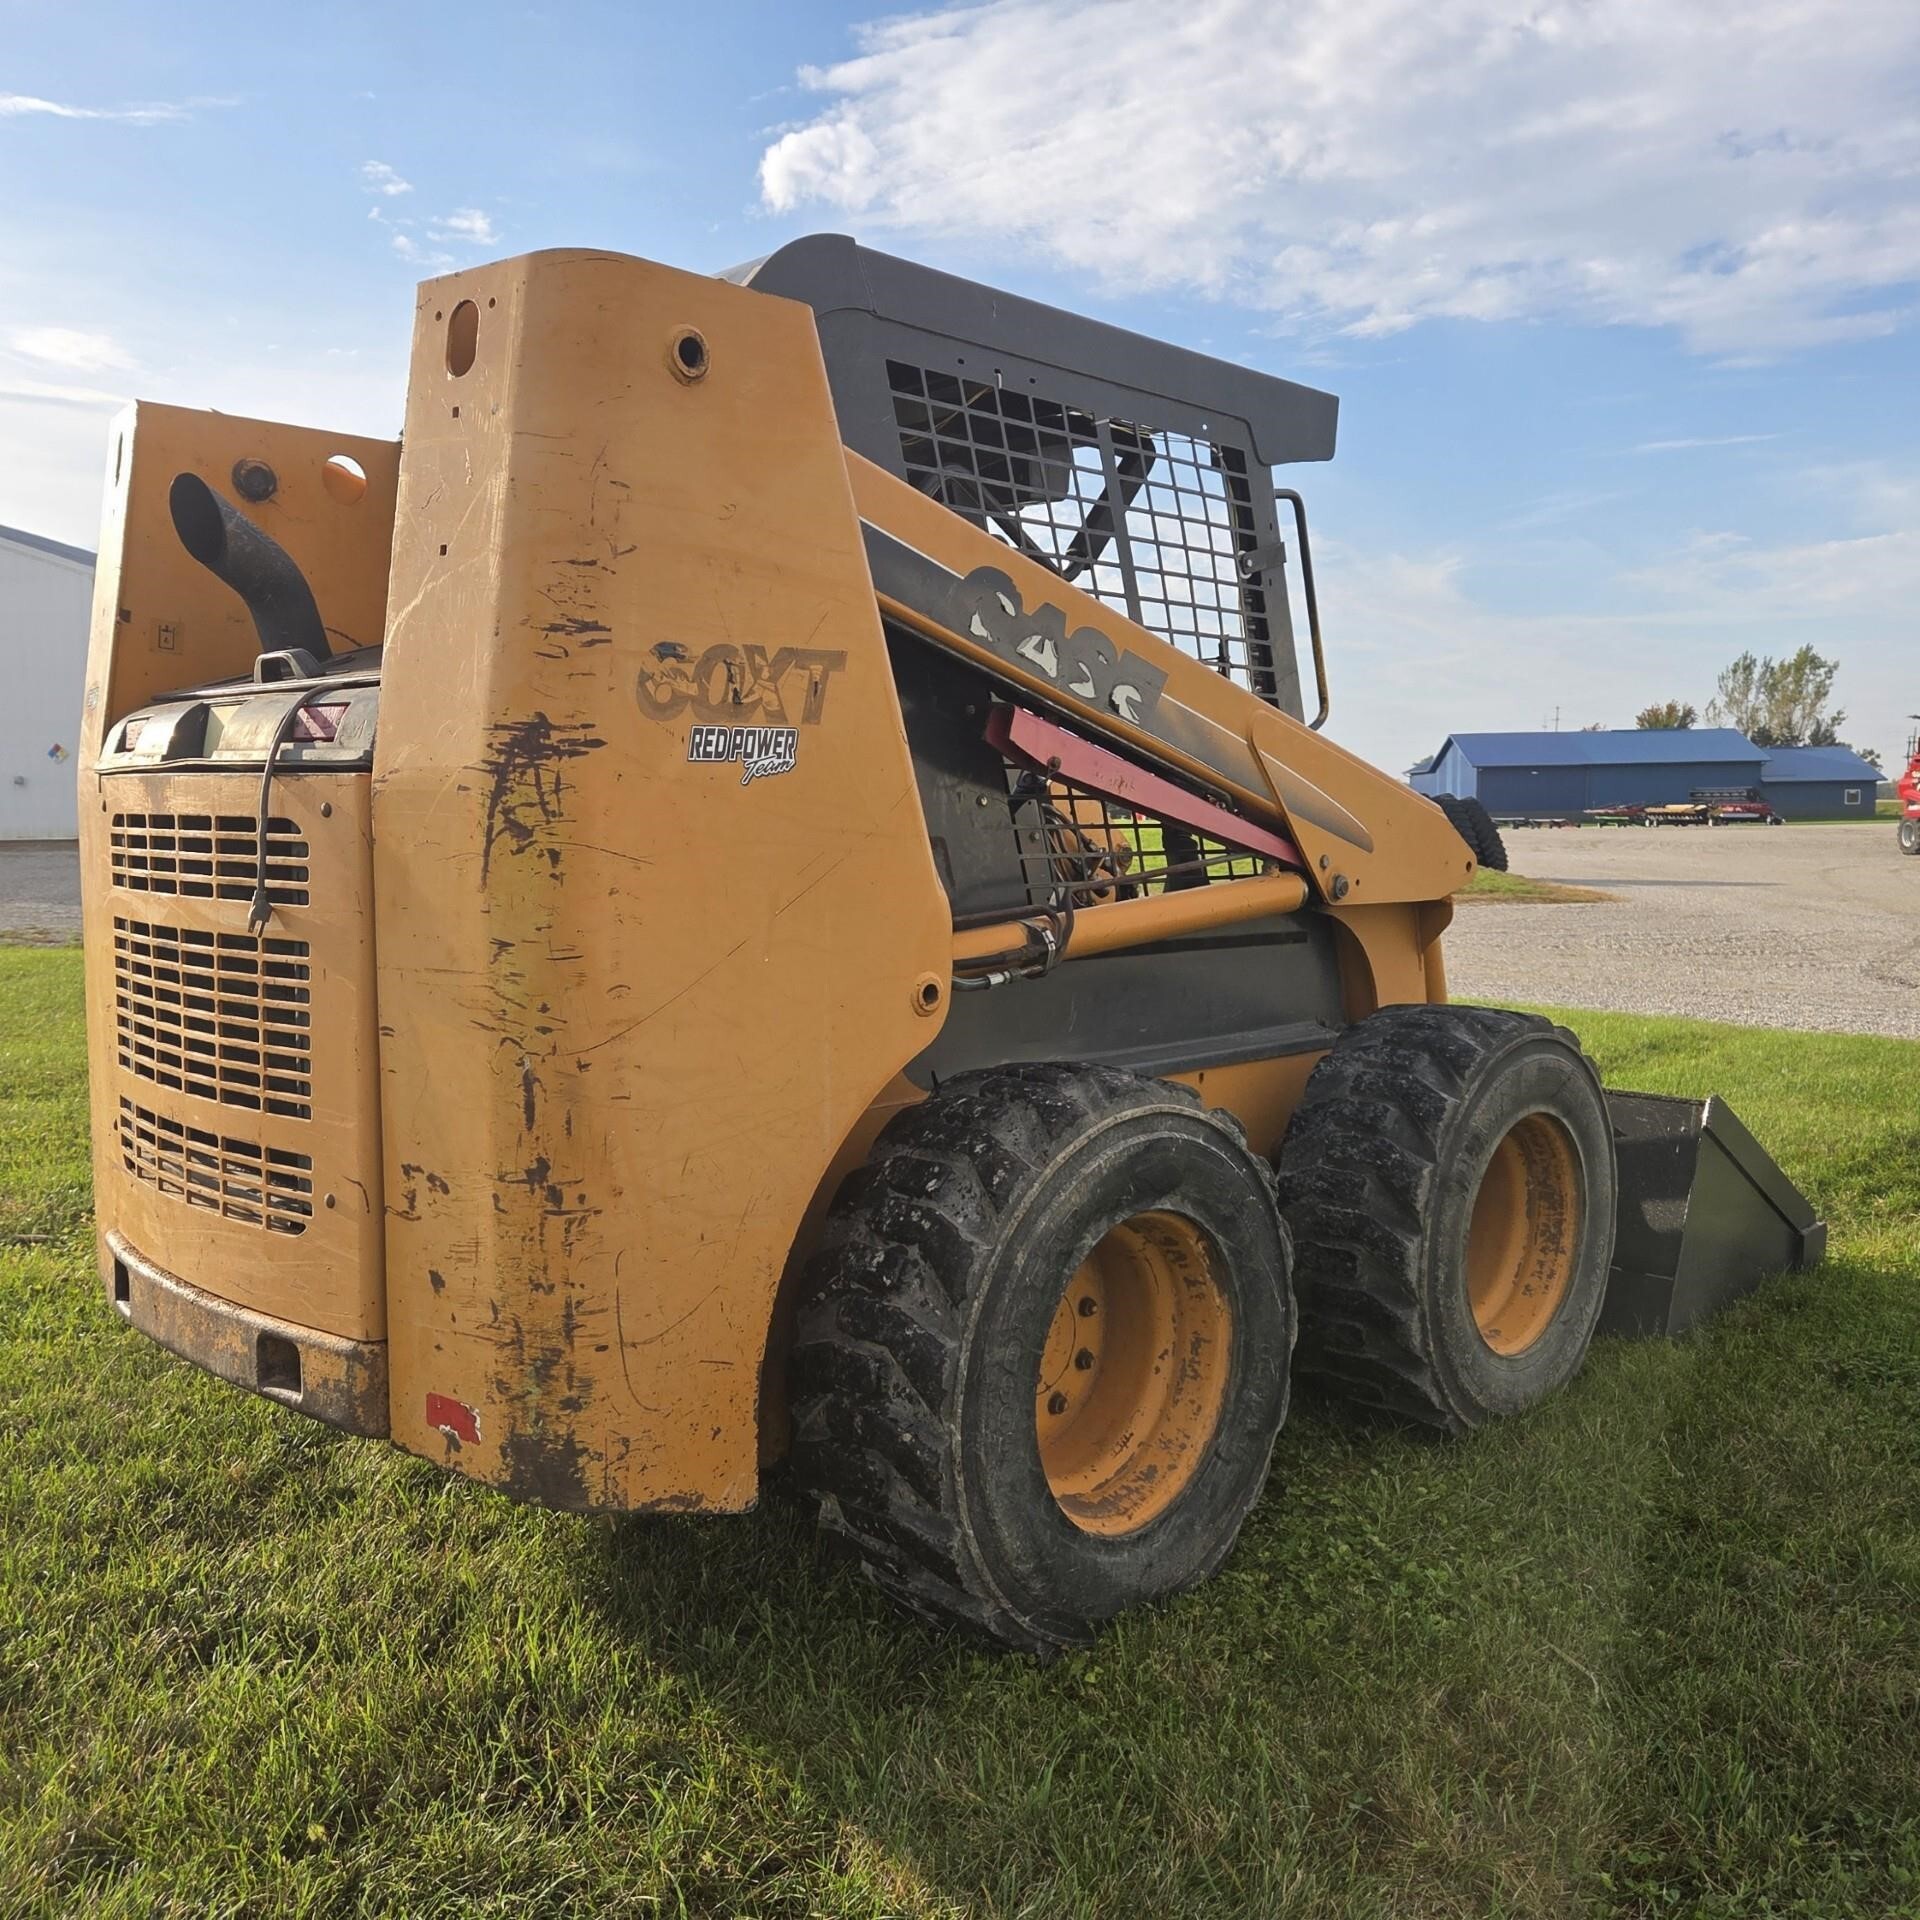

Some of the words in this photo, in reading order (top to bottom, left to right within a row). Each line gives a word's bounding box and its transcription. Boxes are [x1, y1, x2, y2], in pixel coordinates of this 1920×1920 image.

[688, 726, 730, 762] RED
[730, 728, 798, 762] POWER
[741, 754, 796, 785] Team
